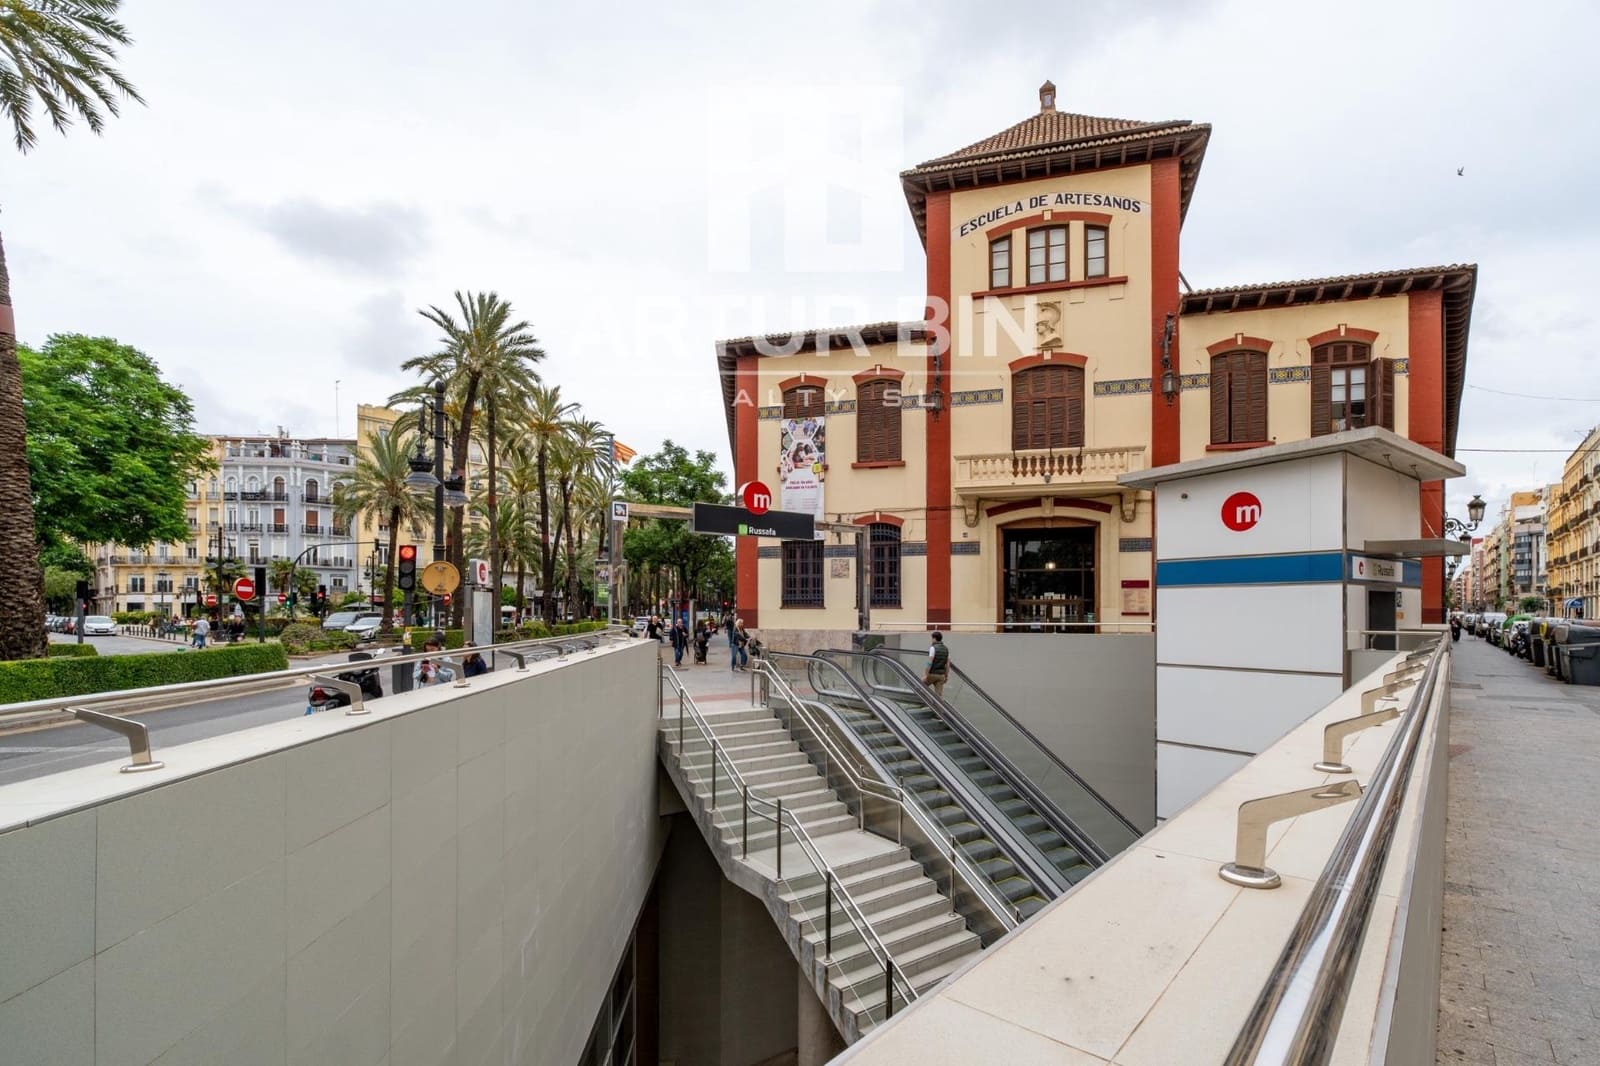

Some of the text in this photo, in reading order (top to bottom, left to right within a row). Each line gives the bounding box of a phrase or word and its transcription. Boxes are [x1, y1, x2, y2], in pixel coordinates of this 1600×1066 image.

[960, 193, 1141, 237] ESCUELA DE ARTESANOS
[754, 493, 769, 508] m
[1236, 505, 1259, 523] m
[748, 526, 776, 536] Russafa
